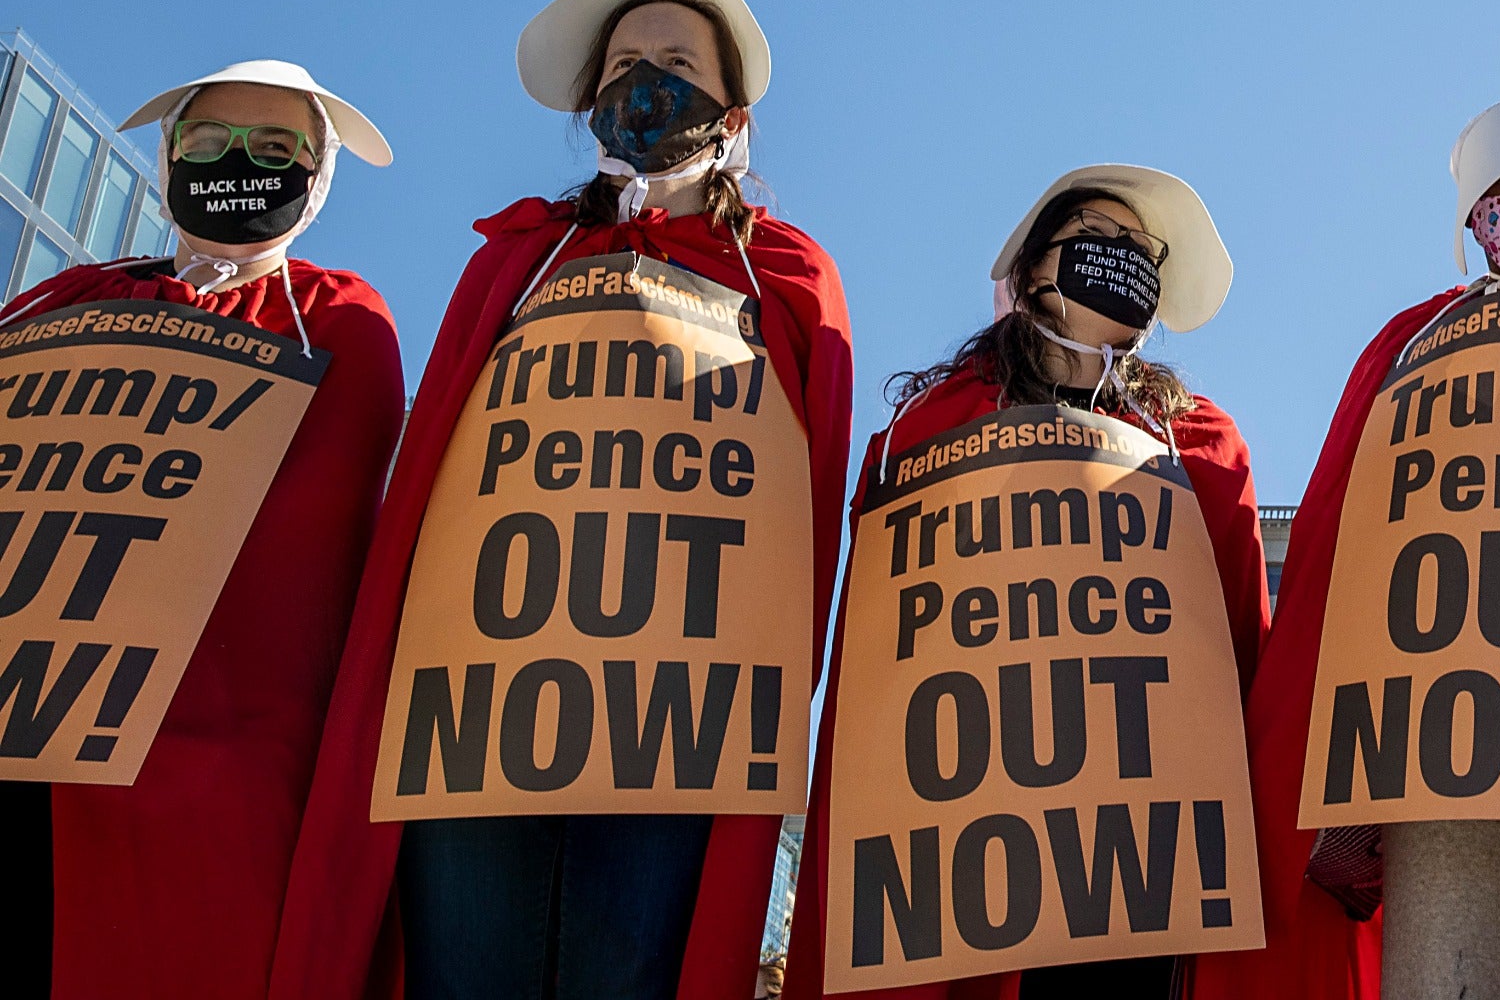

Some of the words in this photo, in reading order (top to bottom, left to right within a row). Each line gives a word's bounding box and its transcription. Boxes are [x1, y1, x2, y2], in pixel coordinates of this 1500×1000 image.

[190, 180, 237, 196] BLACK
[243, 178, 282, 192] LIVES
[206, 198, 267, 213] MATTER
[1075, 242, 1103, 253] FREE
[1106, 246, 1127, 259] THE
[1075, 263, 1103, 277] FEED
[1105, 268, 1125, 283] THE
[1086, 253, 1117, 267] FUND
[1119, 260, 1137, 275] THE
[1139, 268, 1158, 292] YOUTH
[1108, 281, 1127, 296] THE
[1129, 288, 1150, 310] POLICE
[0, 309, 281, 365] efuseFascism.org
[485, 335, 766, 423] Trump/
[477, 418, 756, 498] Pence
[885, 485, 1173, 578] Trump/
[472, 511, 746, 640] OUT
[896, 574, 1172, 662] Pence
[395, 658, 783, 796] NOW!
[904, 656, 1169, 802] OUT
[851, 799, 1232, 968] NOW!
